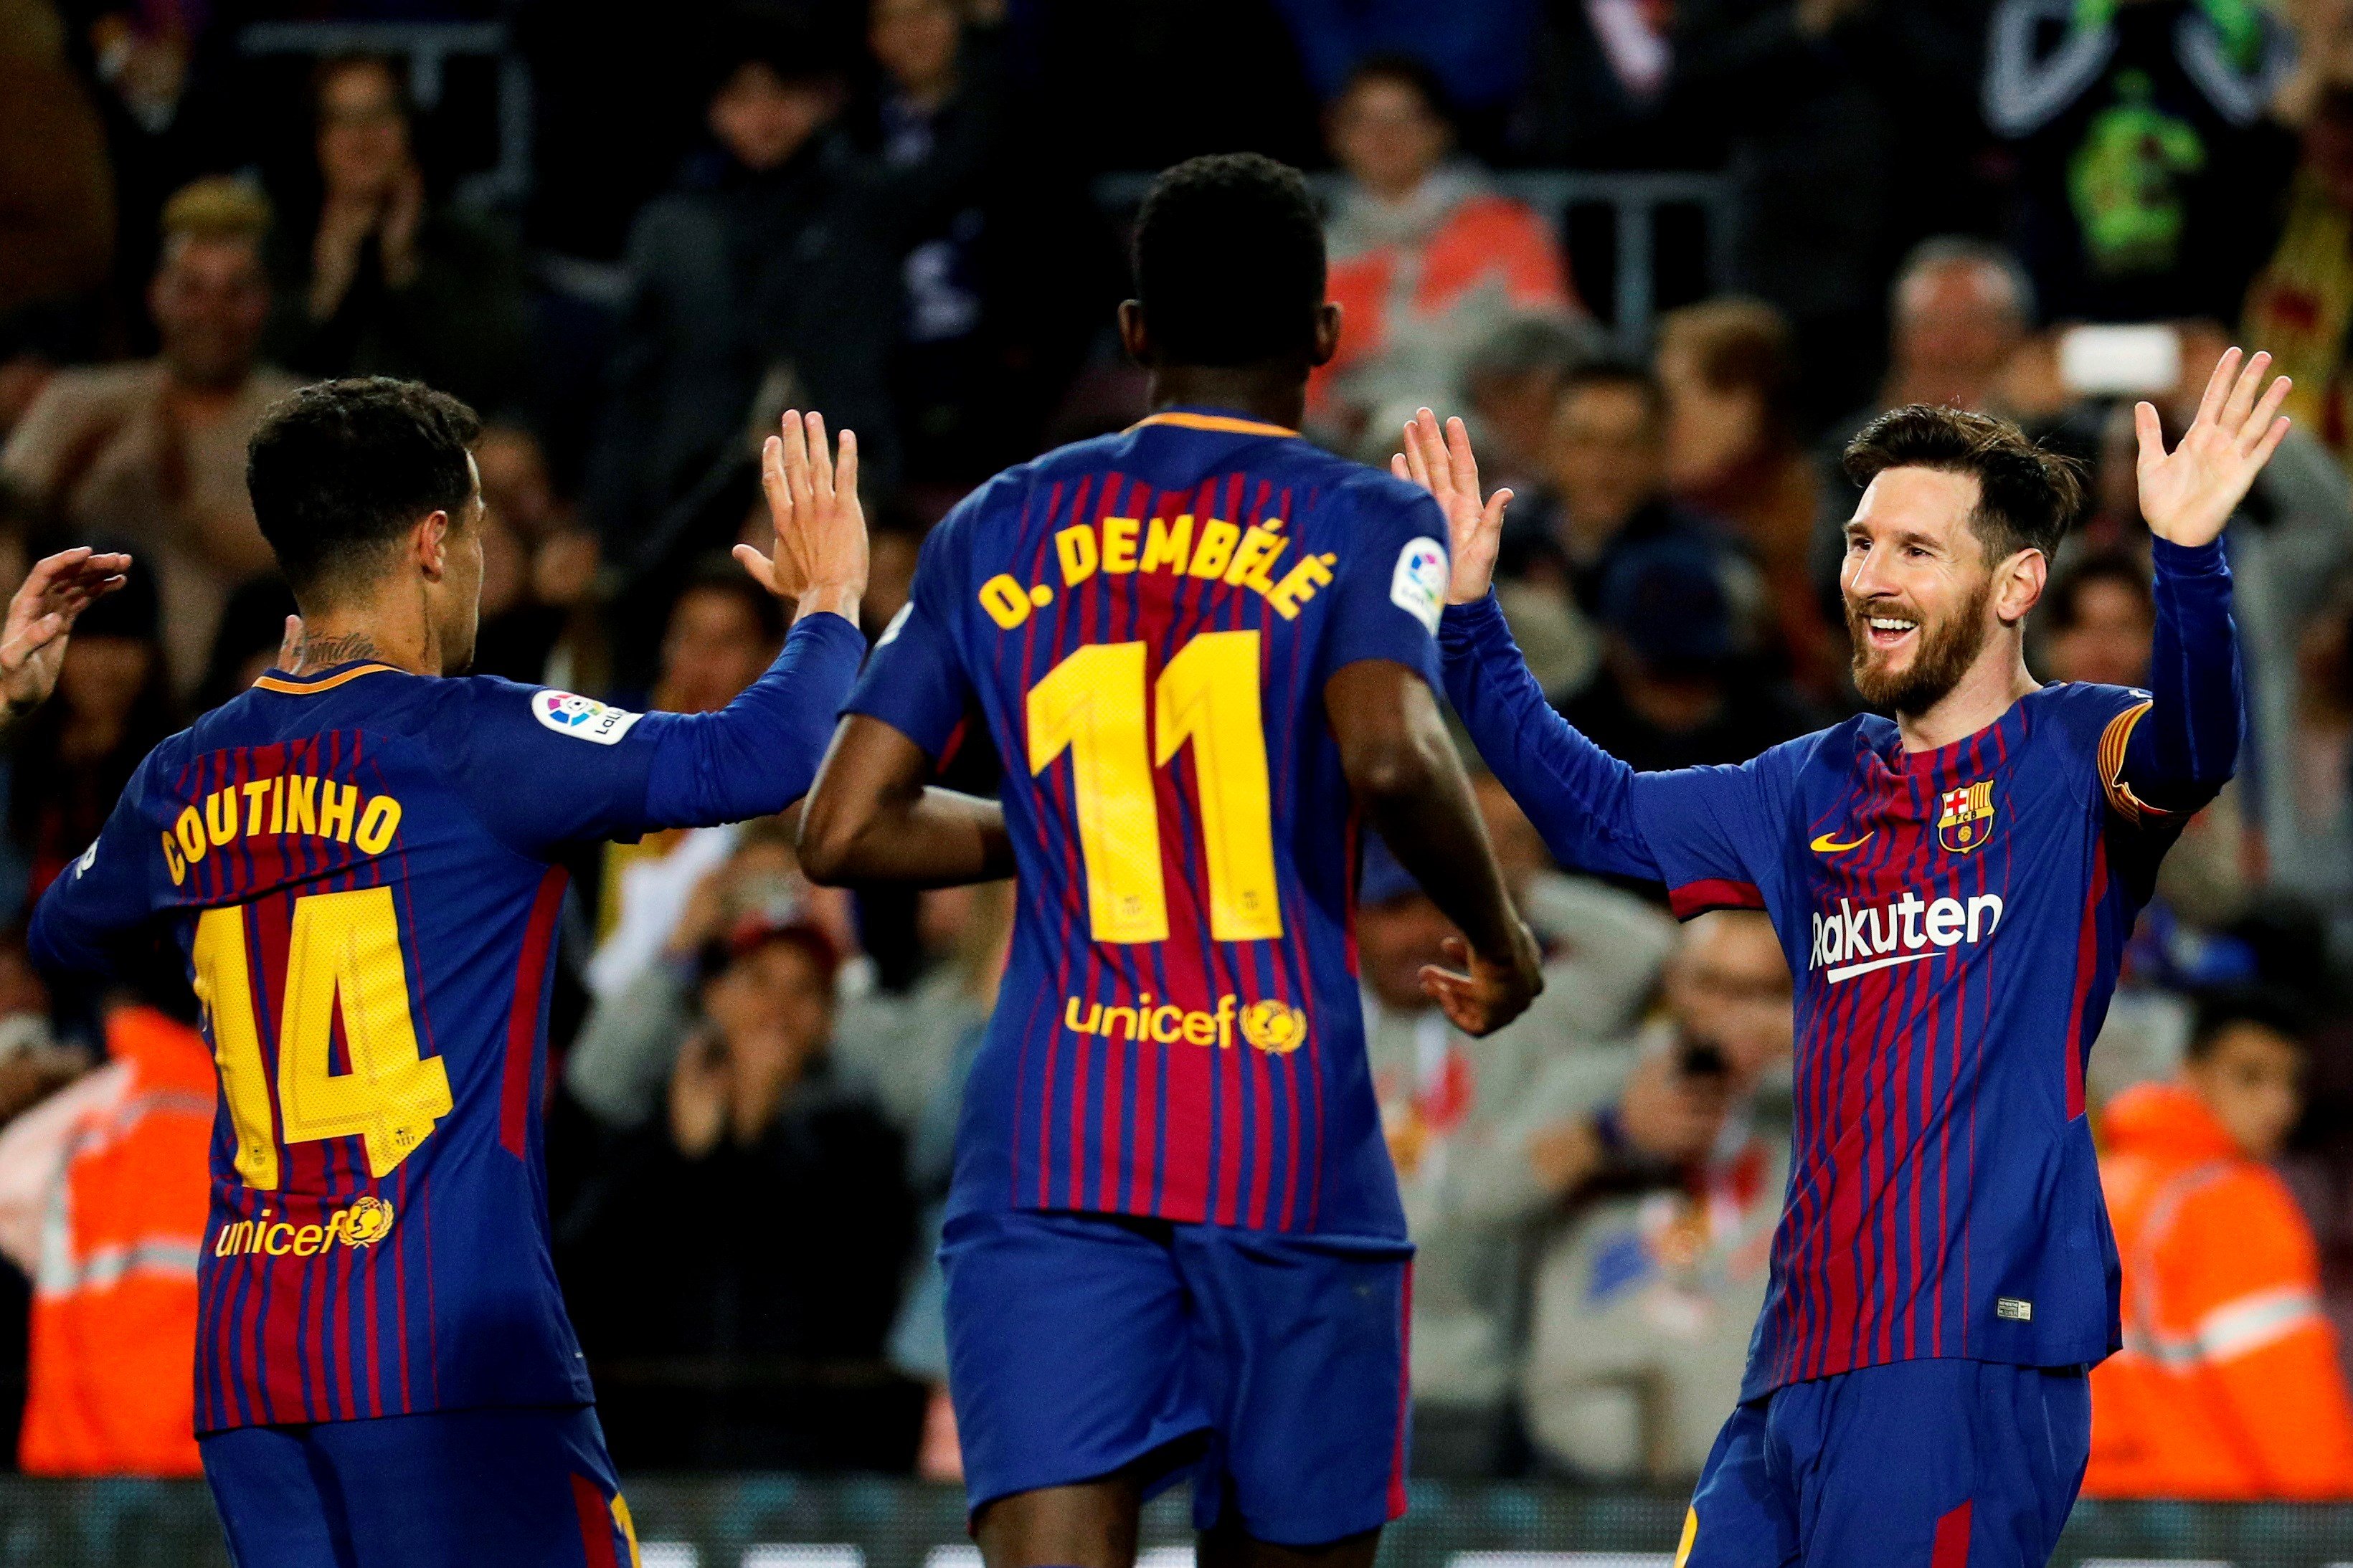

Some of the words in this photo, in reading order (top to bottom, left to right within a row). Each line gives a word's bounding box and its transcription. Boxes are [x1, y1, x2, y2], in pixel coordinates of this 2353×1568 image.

[978, 573, 1054, 630] O.
[1055, 514, 1338, 621] DEMBÉLÉ
[161, 775, 402, 885] COUTINHO
[1026, 629, 1282, 944] 11
[1809, 892, 2003, 971] Rakuten
[193, 886, 453, 1190] 14
[1064, 992, 1237, 1049] unicef
[215, 1209, 348, 1257] unicef
